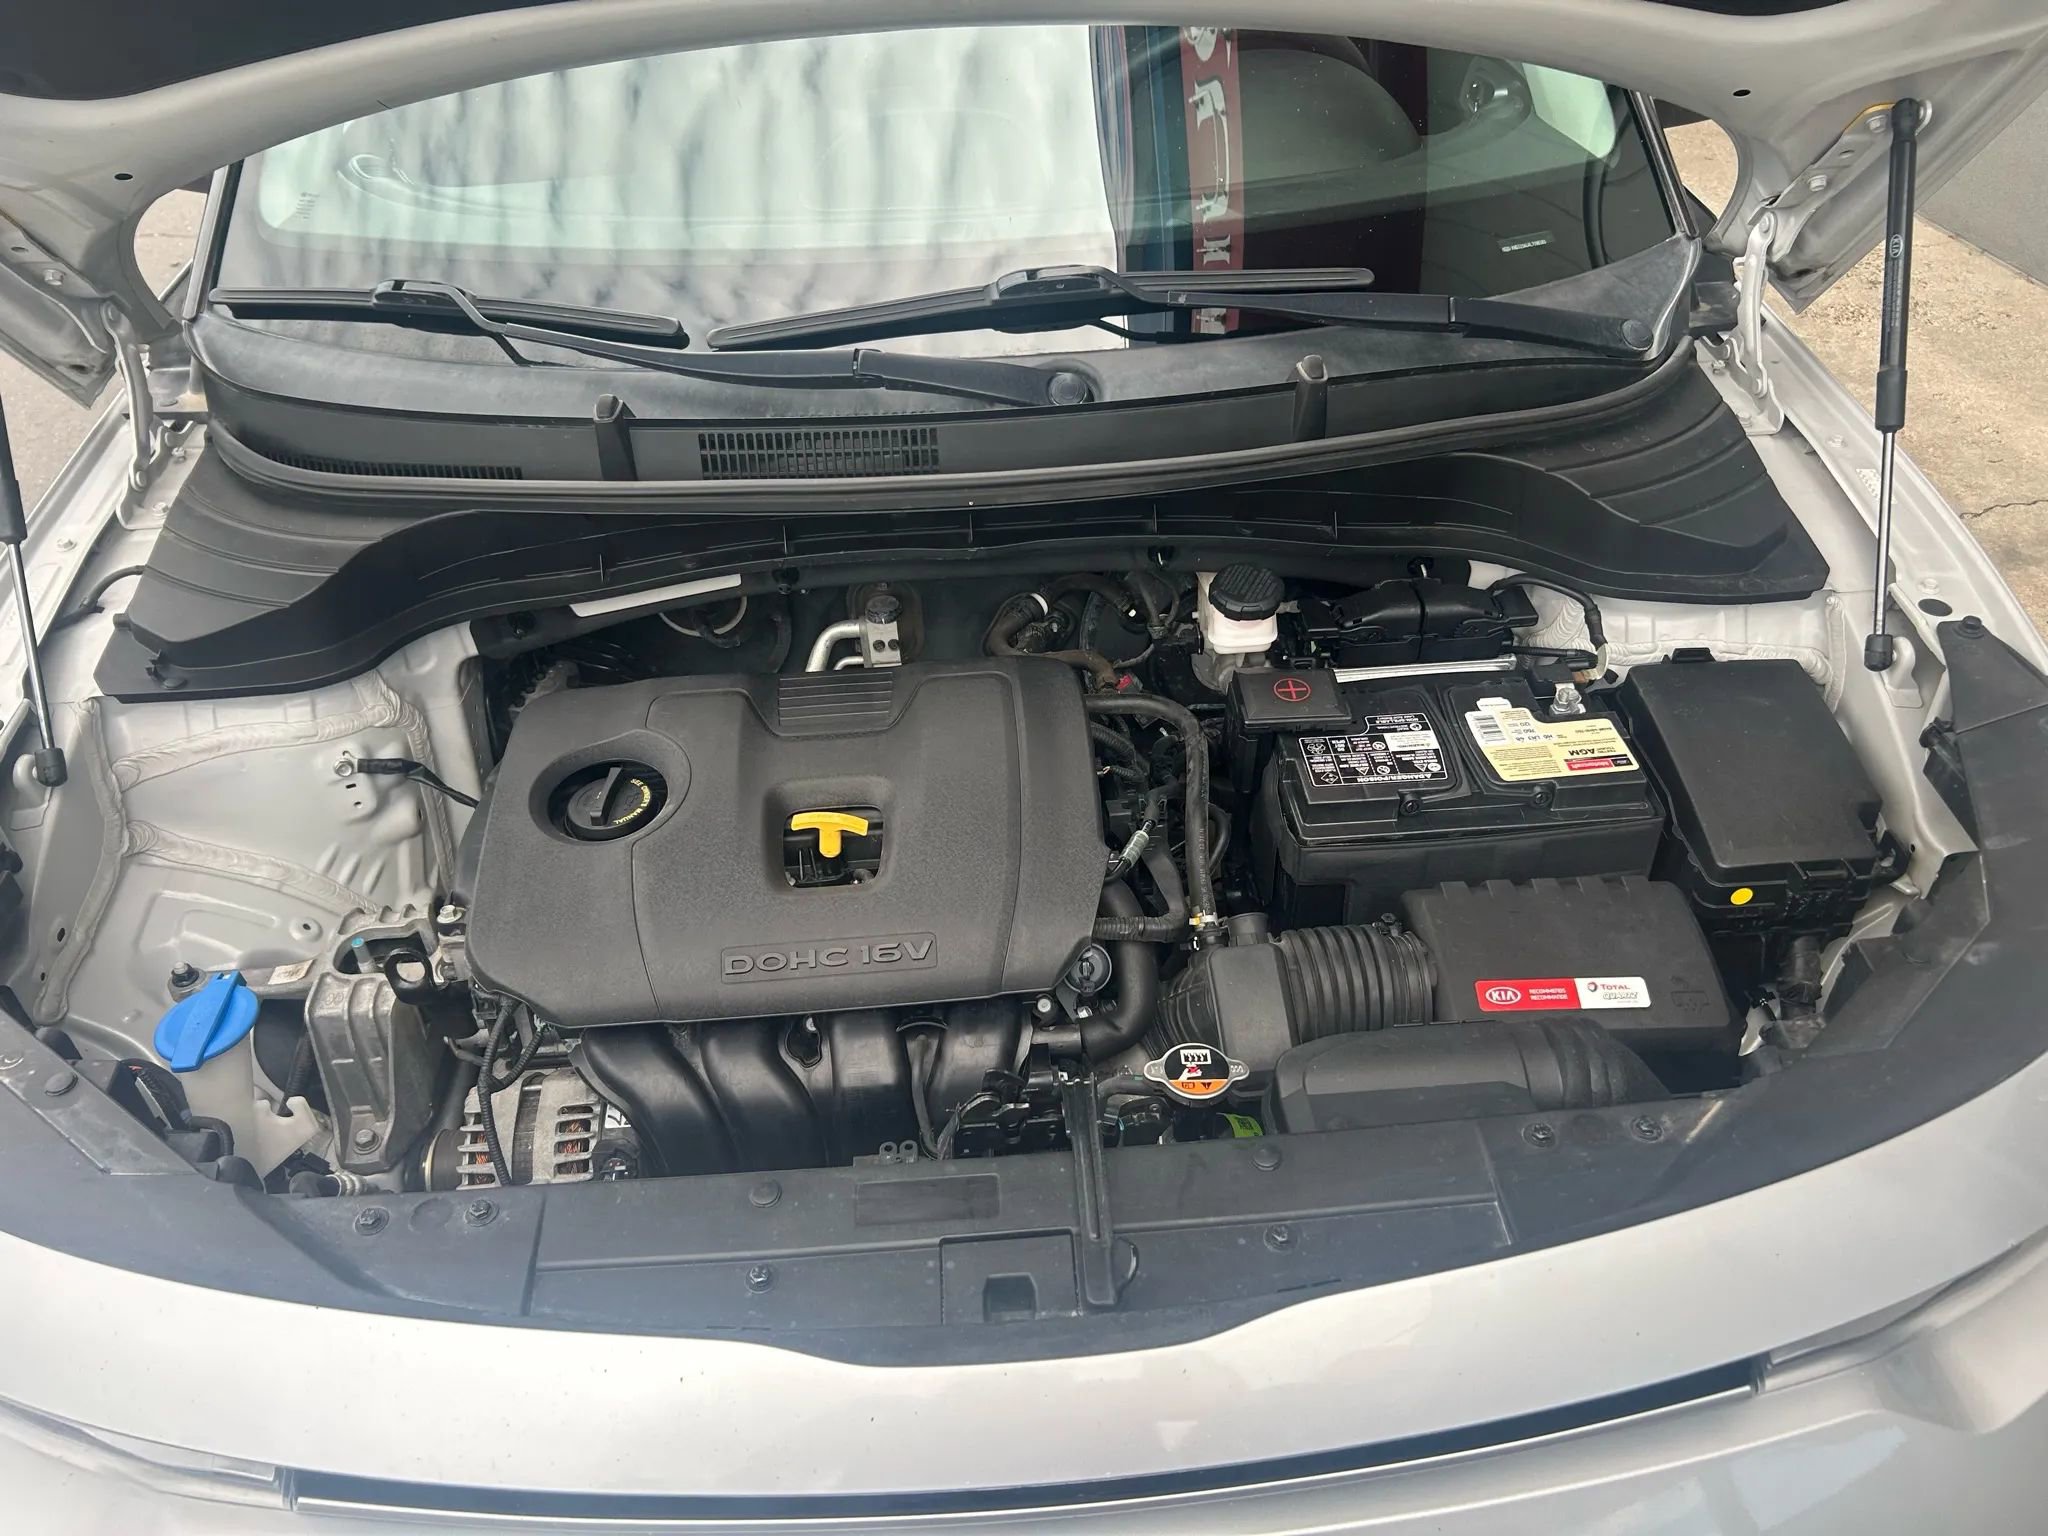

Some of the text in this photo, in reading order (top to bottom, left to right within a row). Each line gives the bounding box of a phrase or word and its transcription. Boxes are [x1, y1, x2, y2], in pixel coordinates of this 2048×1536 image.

[1568, 748, 1596, 756] AGM
[630, 778, 644, 787] SEE
[613, 807, 643, 825] MANUAL
[724, 939, 934, 976] DOHC 16V
[1600, 983, 1631, 991] TOTAL
